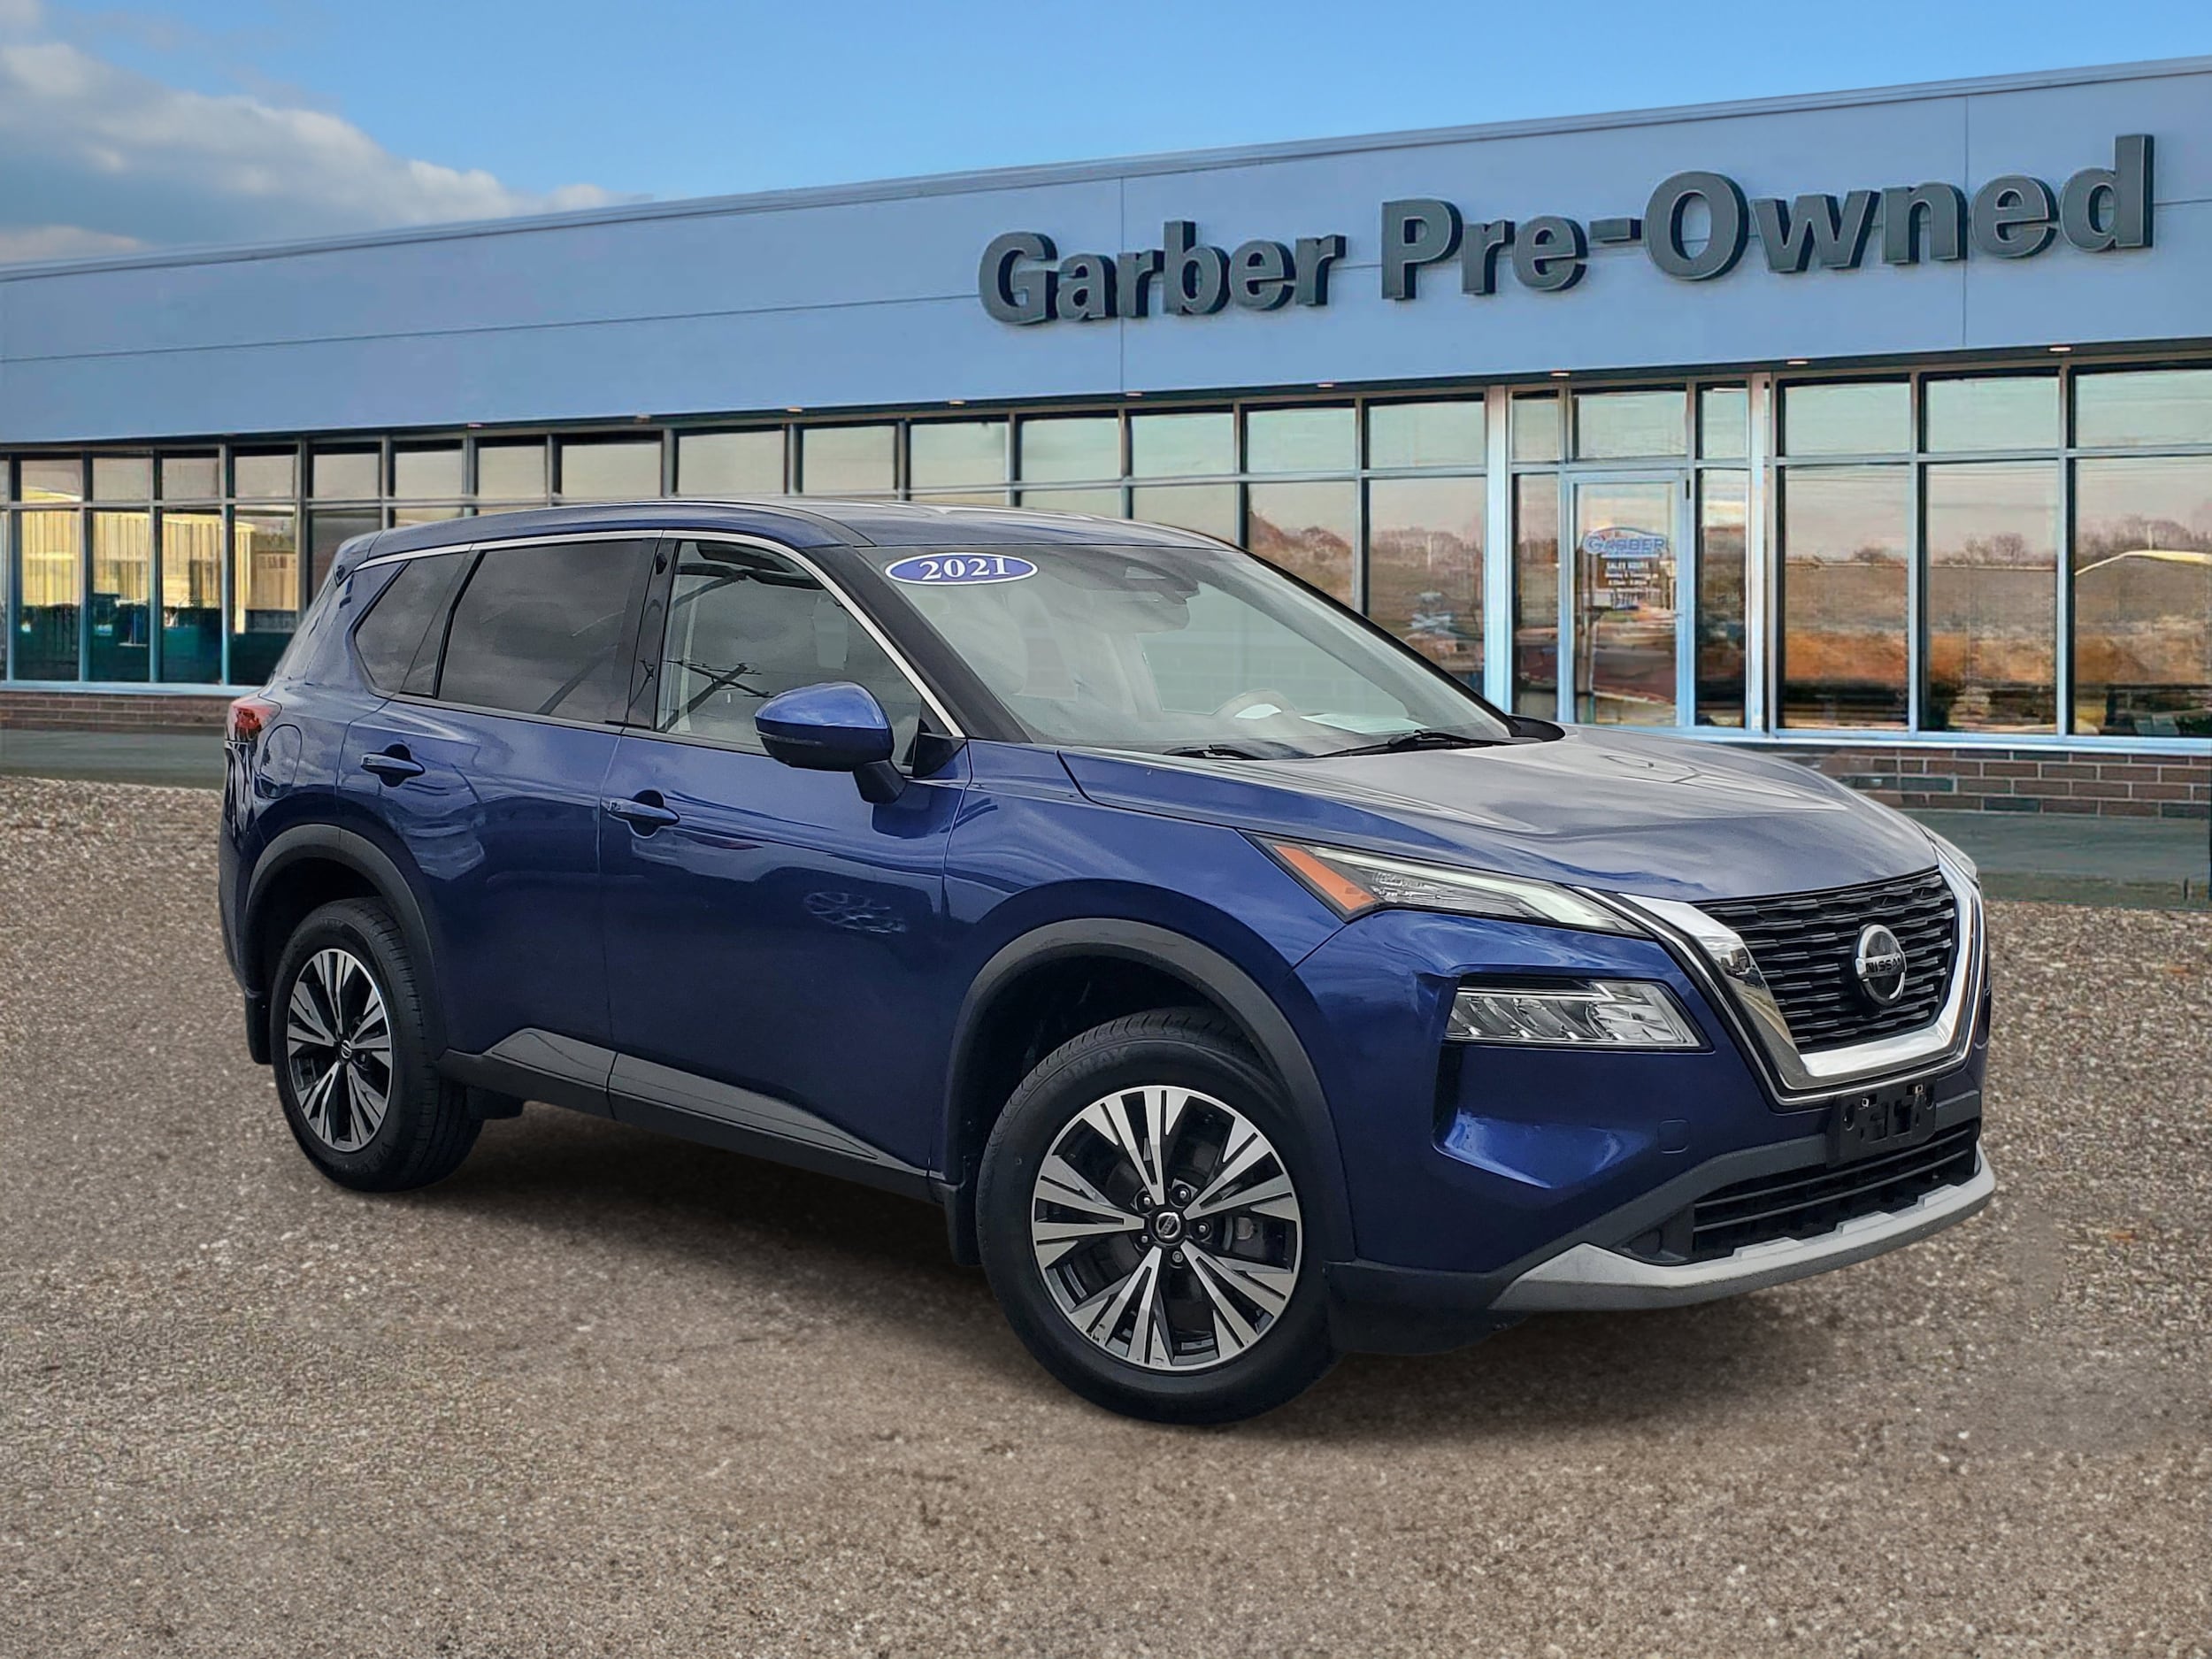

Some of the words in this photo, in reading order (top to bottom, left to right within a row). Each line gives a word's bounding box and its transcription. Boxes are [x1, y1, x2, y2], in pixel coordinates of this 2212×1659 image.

[979, 219, 1346, 325] Garber
[1381, 134, 2154, 300] Pre-Owned
[919, 557, 1010, 580] 2021
